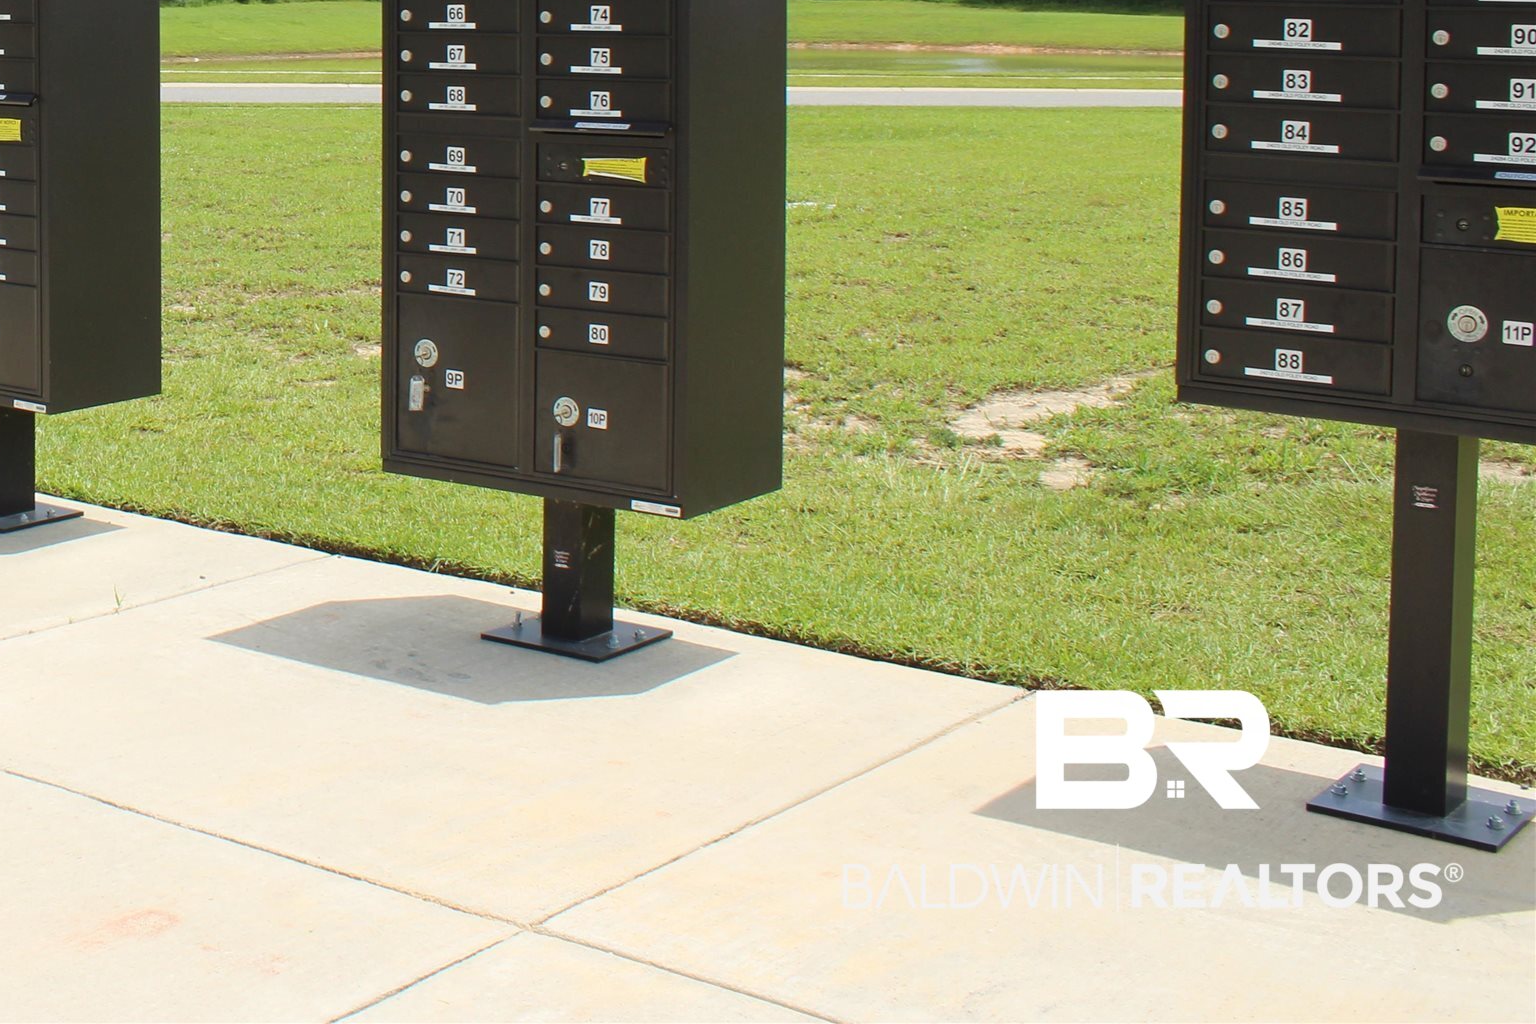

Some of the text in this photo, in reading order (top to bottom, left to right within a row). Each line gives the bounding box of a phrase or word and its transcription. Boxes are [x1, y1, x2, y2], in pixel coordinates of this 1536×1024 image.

[449, 7, 463, 20] 66
[592, 8, 608, 21] 74
[1287, 22, 1309, 38] 82
[1514, 28, 1536, 45] 90
[449, 48, 463, 60] 67
[592, 50, 608, 64] 75
[1286, 73, 1308, 89] 83
[449, 89, 463, 102] 68
[1513, 82, 1535, 99] 91
[592, 94, 608, 107] 76
[1284, 124, 1307, 140] 84
[1512, 136, 1536, 154] 92
[449, 150, 463, 163] 69
[449, 190, 463, 204] 70
[592, 201, 608, 214] 77
[1282, 201, 1304, 217] 85
[449, 231, 462, 244] 71
[592, 243, 607, 257] 78
[1281, 252, 1303, 268] 86
[449, 272, 463, 286] 72
[591, 285, 606, 299] 79
[1279, 302, 1302, 318] 87
[591, 327, 606, 341] 80
[1504, 325, 1532, 341] 11P
[1278, 353, 1300, 370] 88
[447, 372, 462, 385] 9P
[590, 412, 606, 426] 10P
